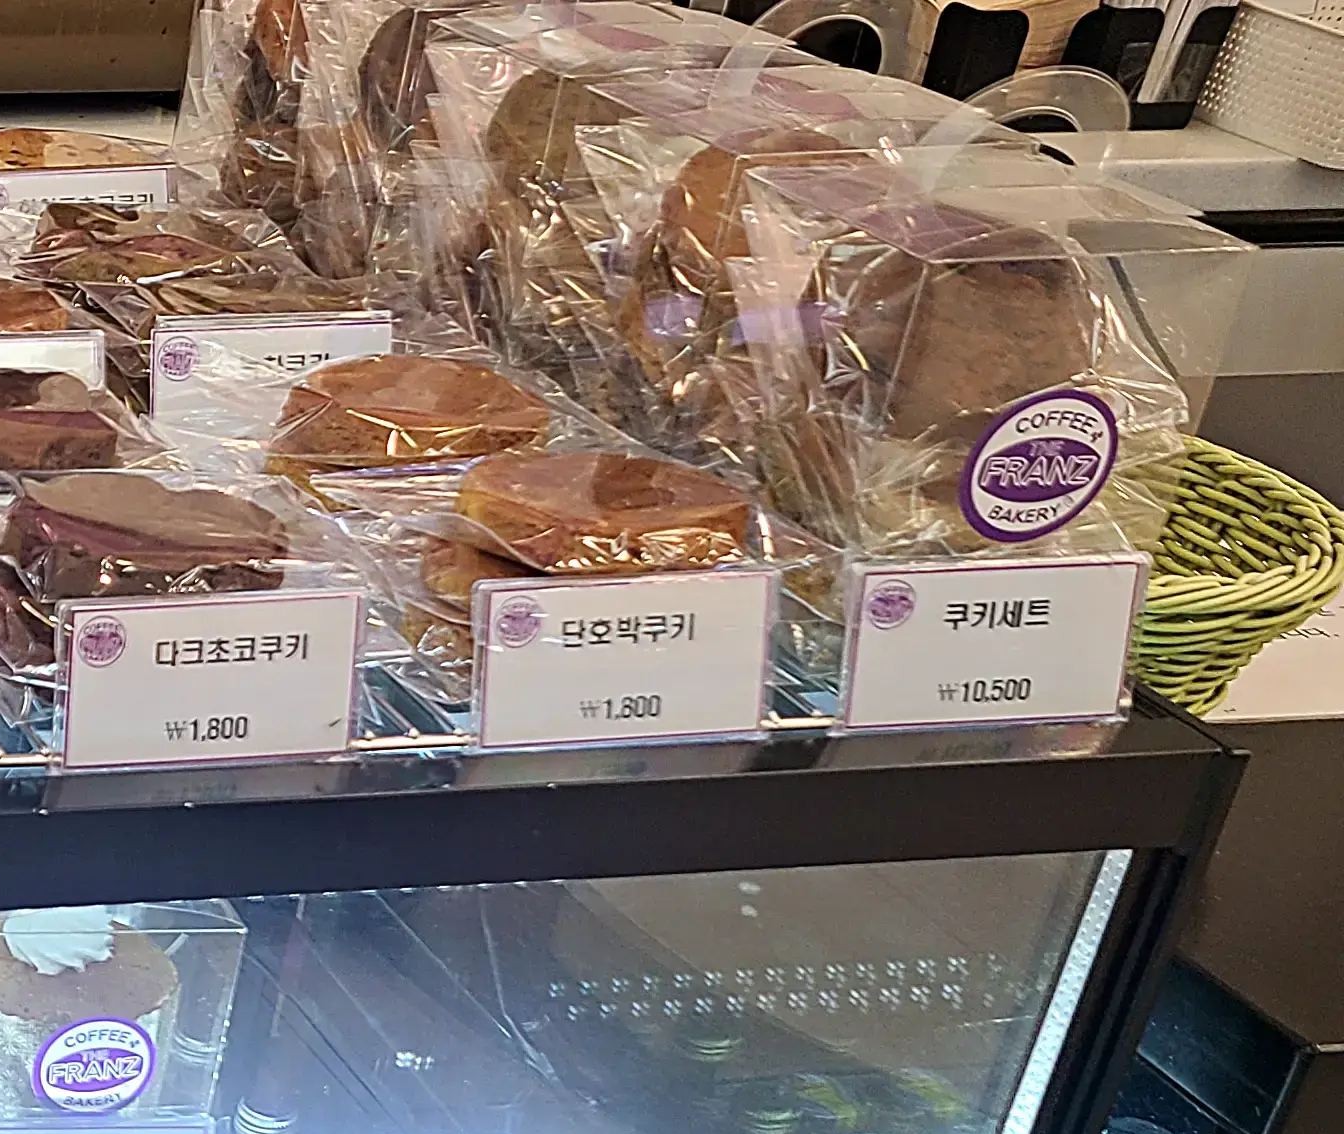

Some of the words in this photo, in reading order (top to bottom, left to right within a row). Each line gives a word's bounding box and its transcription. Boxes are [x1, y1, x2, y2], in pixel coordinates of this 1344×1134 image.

[1015, 407, 1096, 434] COFFEE
[979, 451, 1101, 488] FRANZ
[986, 504, 1059, 524] BAKERY
[560, 611, 696, 648] 단호박쿠키
[943, 598, 1051, 632] 쿠키세트
[154, 633, 309, 668] 다크초코쿠키
[937, 677, 1031, 705] ₩10,500
[165, 716, 248, 743] ₩1,800
[64, 1029, 132, 1049] COFFEE
[47, 1056, 142, 1086] FRANZ
